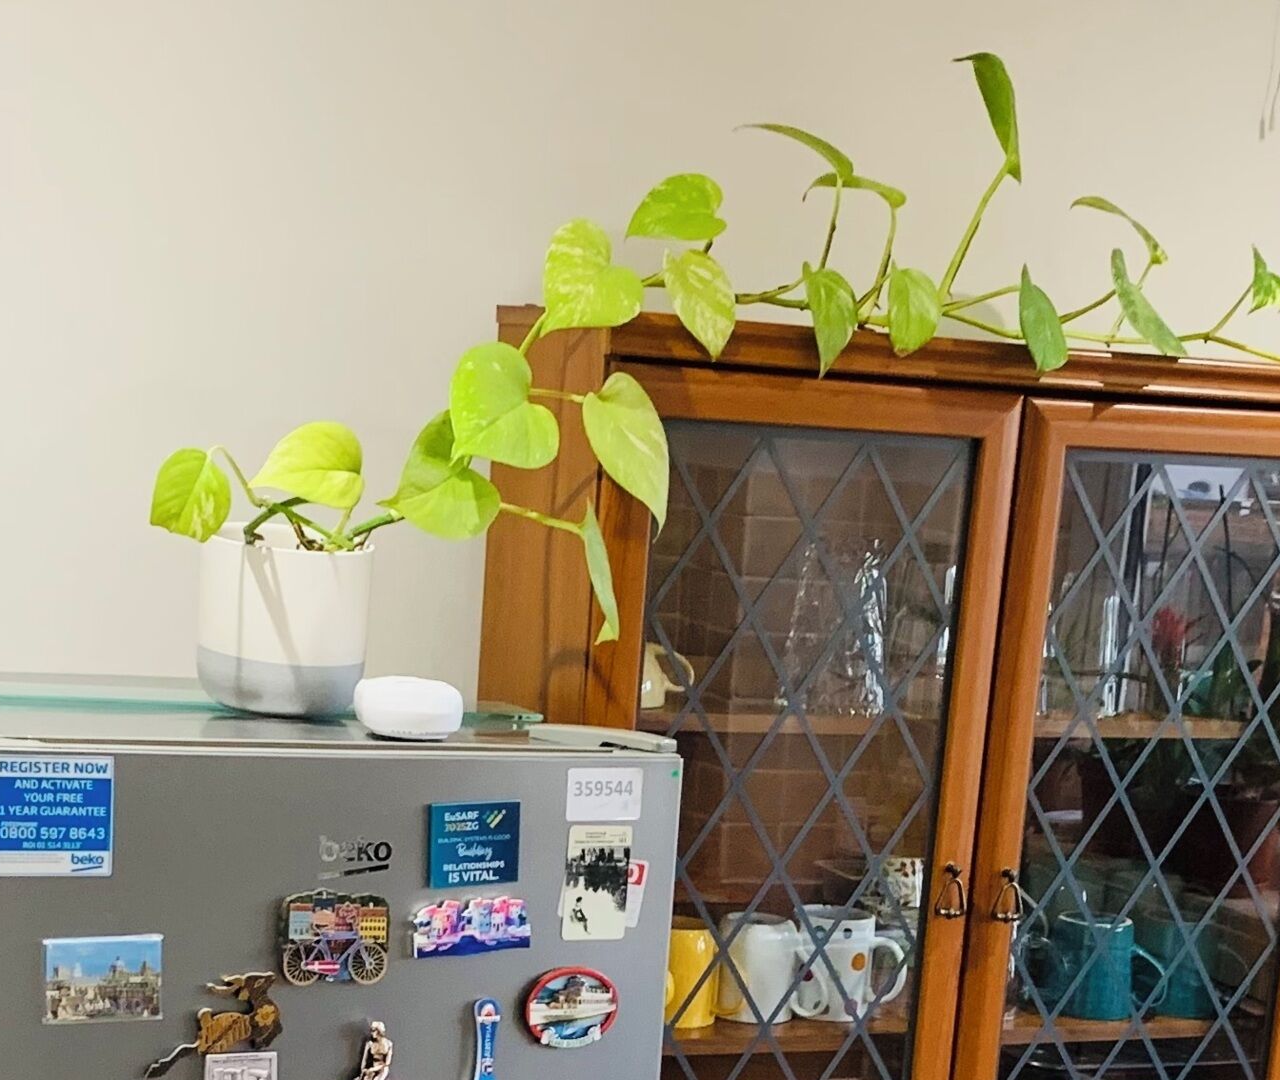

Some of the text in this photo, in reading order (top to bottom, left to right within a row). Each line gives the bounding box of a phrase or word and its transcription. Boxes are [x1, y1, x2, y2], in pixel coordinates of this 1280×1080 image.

[0, 761, 109, 774] REGISTER NOW
[14, 779, 94, 791] AND ACTIVATE
[573, 780, 633, 797] 359544
[24, 793, 84, 804] YOUR FREE
[0, 805, 107, 817] 1 YEAR GUARANTEE
[444, 811, 480, 822] EuSARF
[0, 827, 106, 840] 0800 597 8643
[71, 853, 104, 865] beko
[443, 860, 505, 871] RELATIONSHIPS
[448, 870, 500, 883] IS VITAL.
